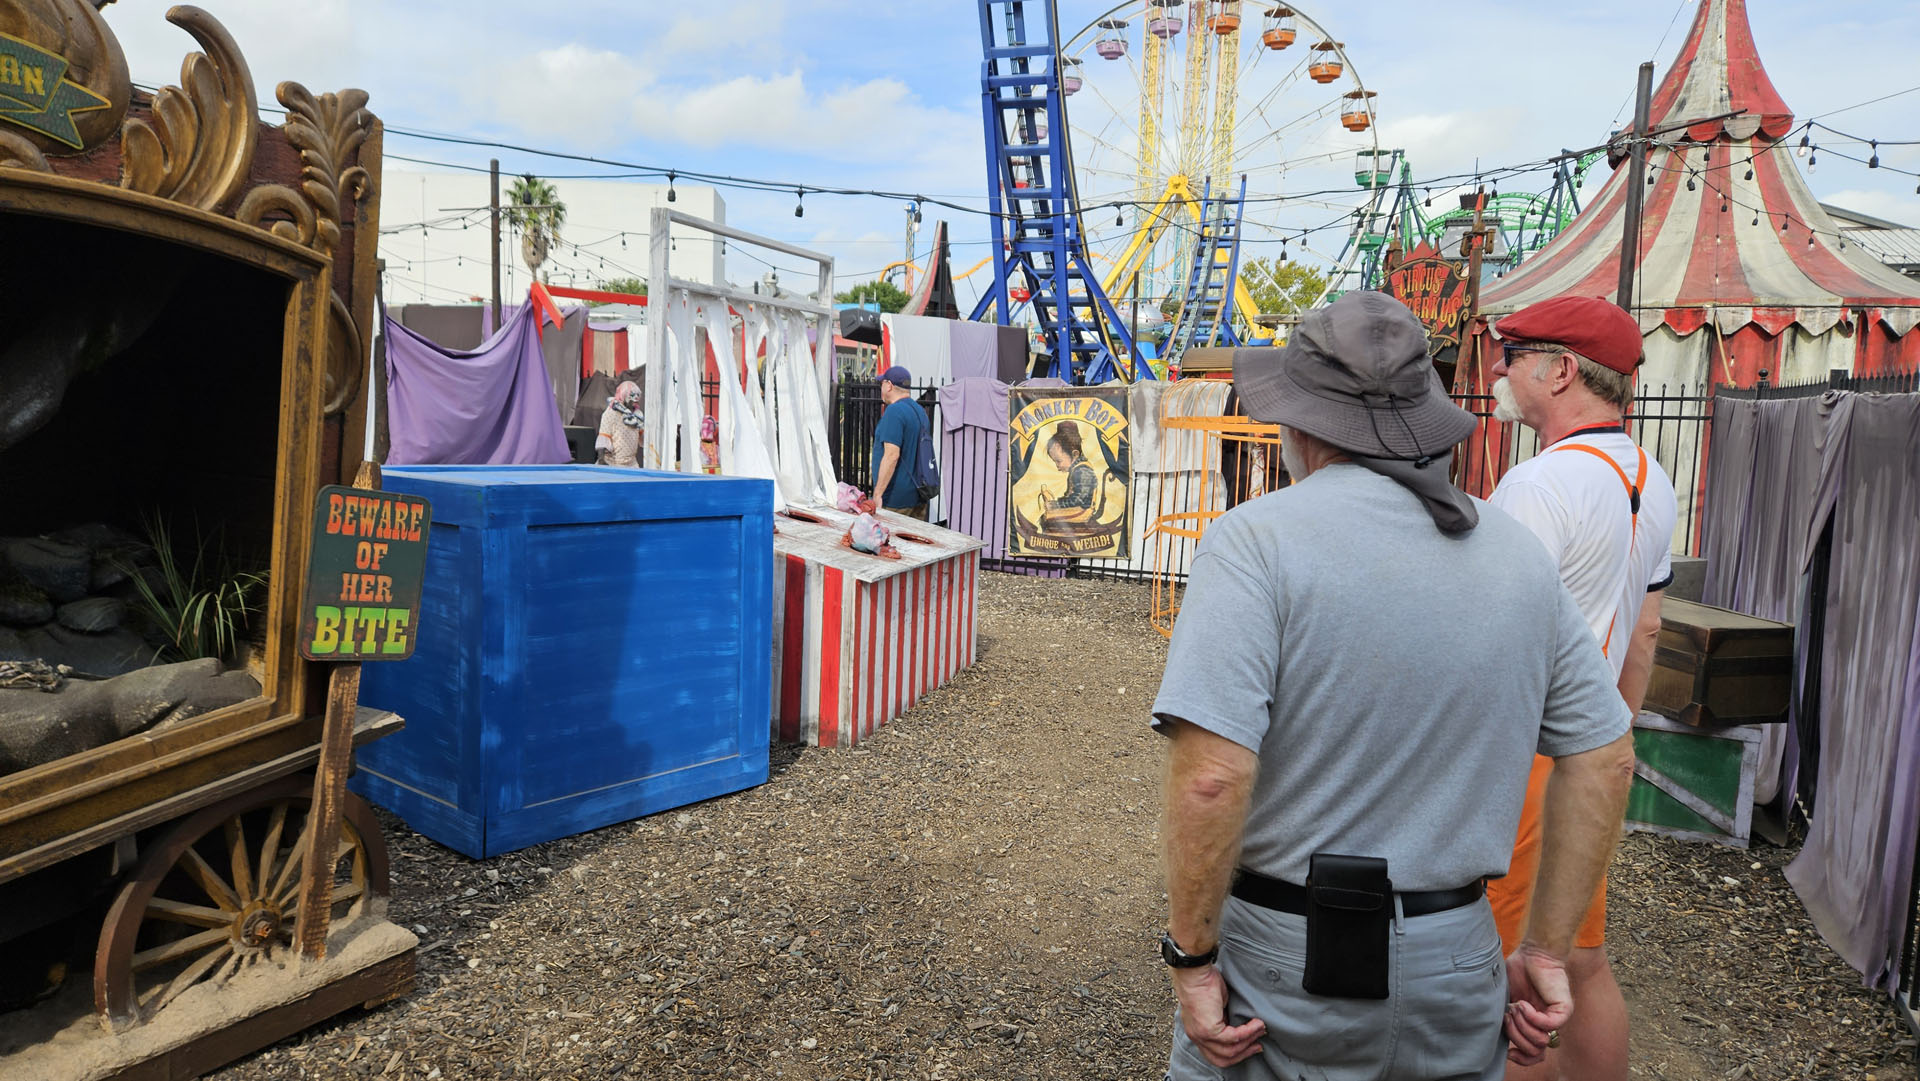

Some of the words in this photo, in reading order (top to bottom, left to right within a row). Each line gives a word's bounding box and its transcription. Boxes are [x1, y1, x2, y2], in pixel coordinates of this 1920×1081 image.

[1400, 266, 1441, 297] CIRCUS
[1402, 296, 1460, 328] ZERKUS
[1018, 399, 1082, 434] MONKEY
[1085, 400, 1119, 431] BOY
[326, 493, 424, 542] BEWARE
[356, 541, 389, 570] OF
[1029, 535, 1059, 550] UNIQUE
[1073, 534, 1111, 551] WEIRD!
[340, 573, 393, 603] HER
[311, 605, 410, 654] BITE
